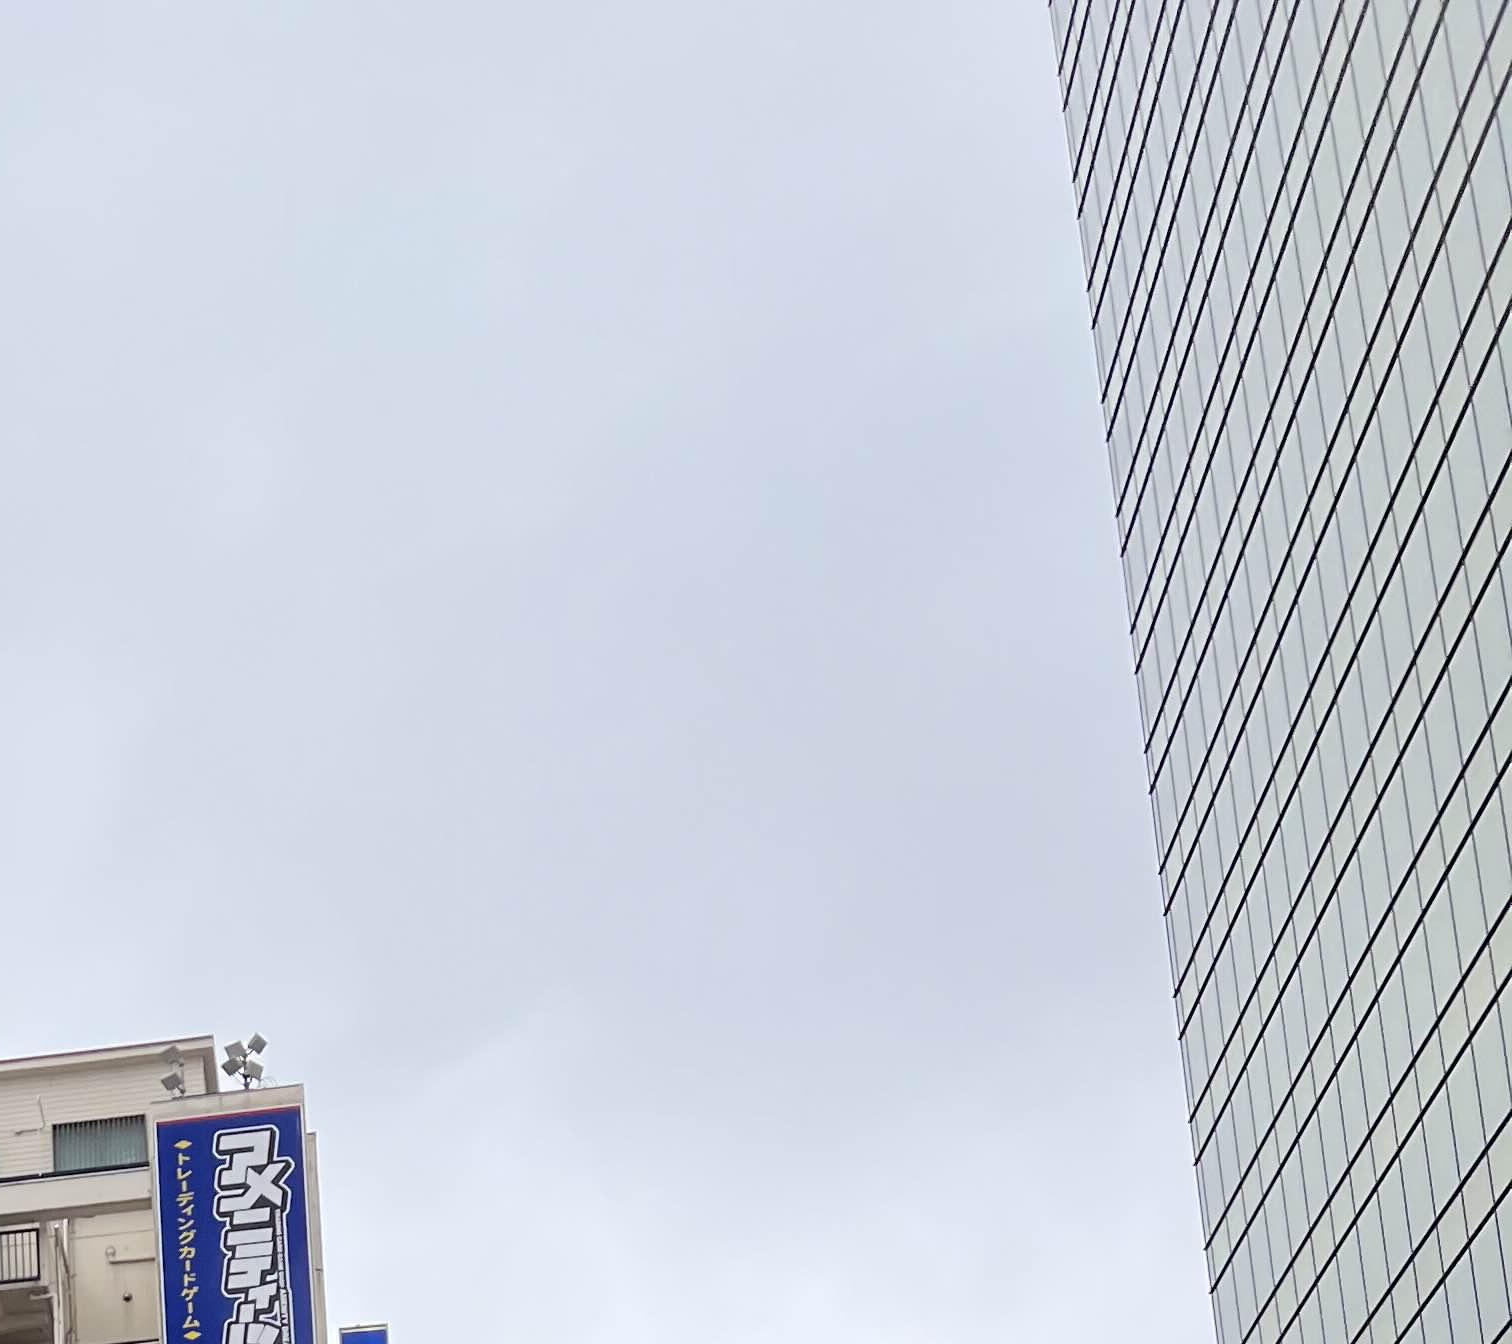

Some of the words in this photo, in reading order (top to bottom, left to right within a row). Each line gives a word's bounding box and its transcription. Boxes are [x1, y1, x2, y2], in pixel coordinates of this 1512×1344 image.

[175, 1150, 201, 1330] トレーディングカードゲーム
